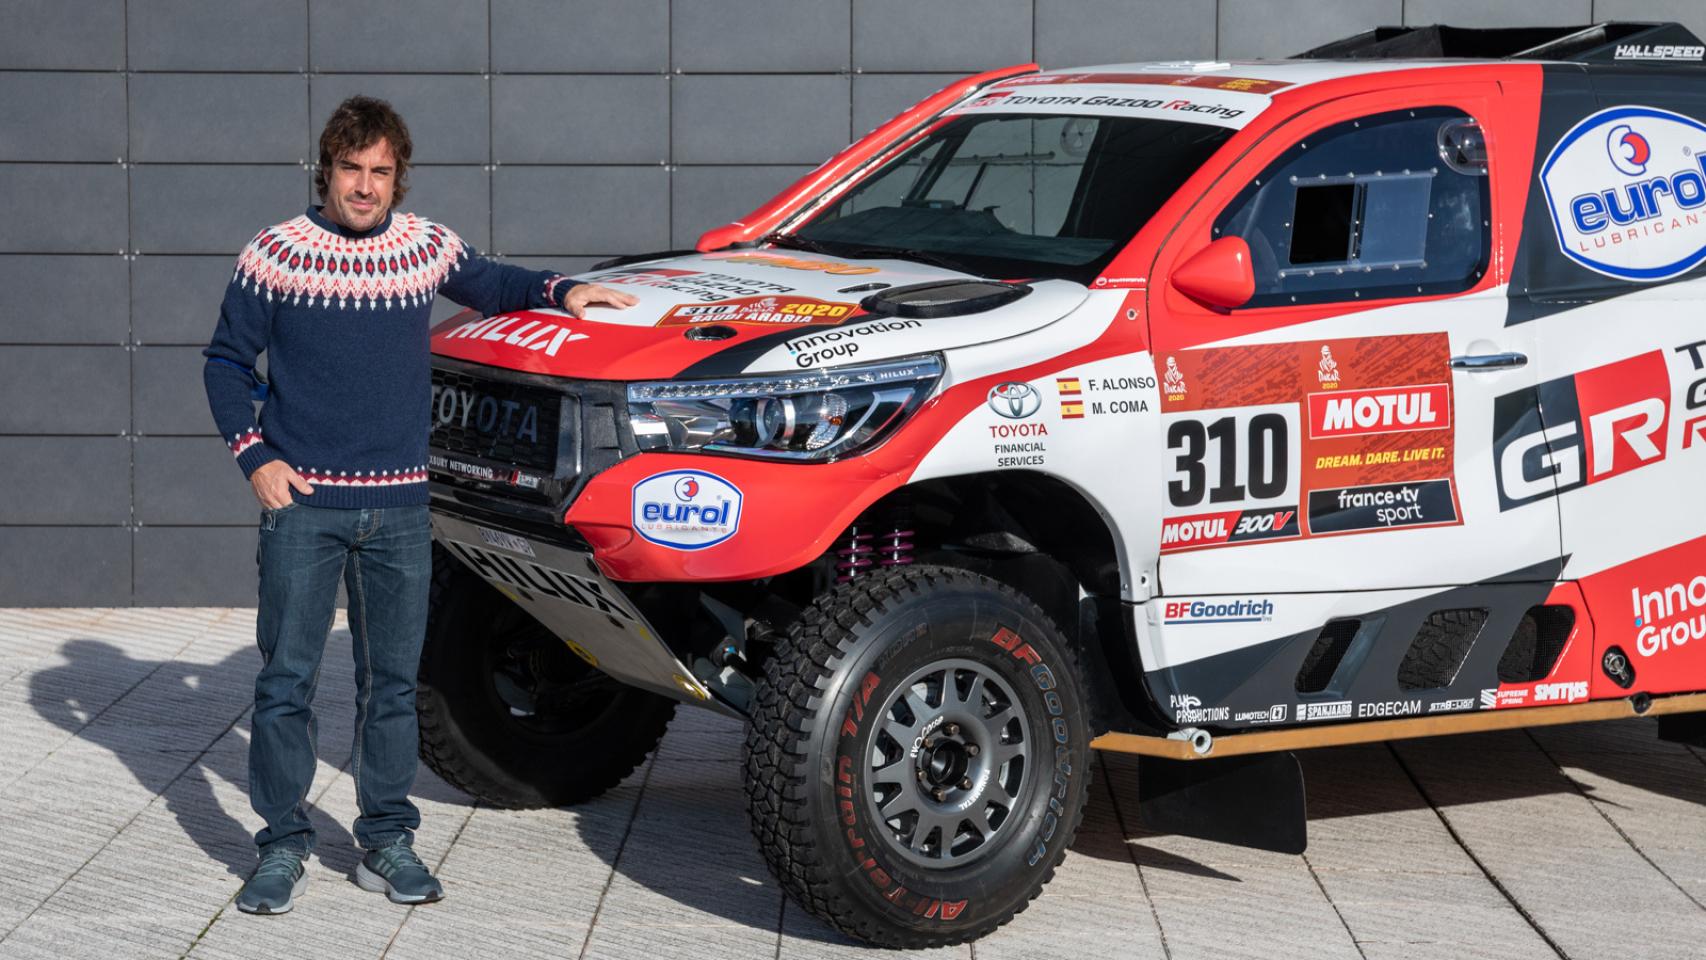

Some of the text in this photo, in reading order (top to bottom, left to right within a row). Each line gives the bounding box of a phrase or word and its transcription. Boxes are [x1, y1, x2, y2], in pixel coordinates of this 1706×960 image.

[1612, 44, 1705, 59] HALLSPEED
[1004, 95, 1083, 106] TOYOTA
[1082, 96, 1164, 108] GAZOO
[1162, 99, 1245, 119] Racing
[1580, 210, 1706, 252] LUBRICAN
[684, 306, 731, 315] 310
[780, 303, 849, 317] 2020
[743, 312, 814, 323] ARABIA
[444, 316, 590, 357] HILUX
[784, 319, 922, 353] Innovation
[796, 341, 859, 368] Group
[880, 368, 914, 379] HILUX
[1089, 376, 1156, 391] F. ALONSO
[1092, 400, 1149, 415] M. COMA
[1322, 393, 1436, 430] MOTUL
[989, 423, 1048, 438] TOYOTA
[994, 442, 1046, 454] FINANCIAL
[1501, 397, 1666, 500] GR
[997, 456, 1045, 467] SERVICES
[1167, 413, 1289, 508] 310
[1316, 447, 1445, 470] DREAM. DARE. LIVE IT.
[449, 460, 494, 479] NETWORKING
[641, 500, 730, 526] eurol
[1376, 504, 1423, 528] sport
[1162, 511, 1295, 544] MOTUL 300V
[1165, 599, 1274, 618] BFGoodrich
[1497, 689, 1529, 698] SUPREME
[1501, 697, 1524, 705] SPRING
[1534, 681, 1588, 702] SMITHS
[1235, 710, 1270, 721] LUMOTECH
[1307, 703, 1352, 717] SPANJAARD
[1358, 700, 1421, 717] EDGECAM
